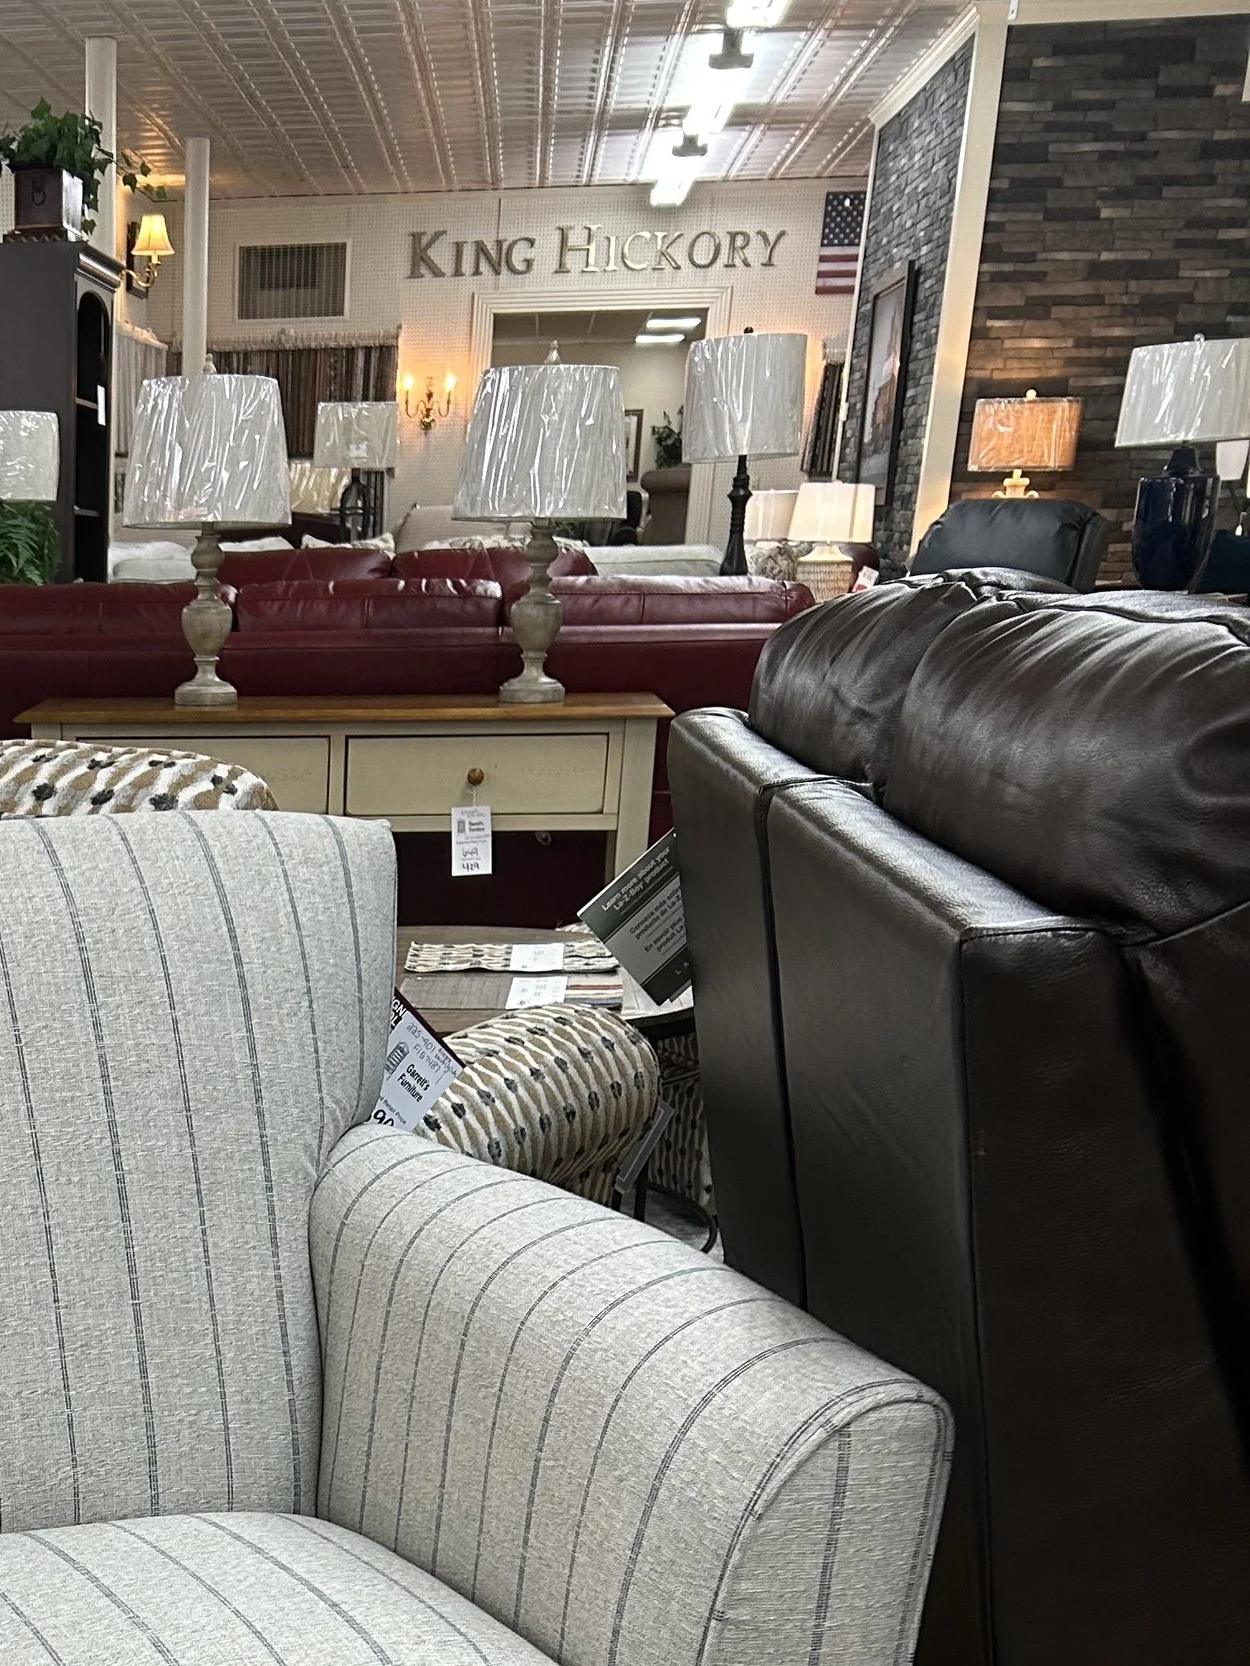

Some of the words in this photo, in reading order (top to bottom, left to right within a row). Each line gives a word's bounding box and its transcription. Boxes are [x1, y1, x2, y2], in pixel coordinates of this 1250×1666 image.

[406, 229, 537, 279] KING
[553, 223, 788, 275] HICKORY
[601, 892, 622, 911] Learn
[620, 877, 639, 894] more
[637, 860, 656, 879] about
[655, 846, 671, 862] your
[643, 858, 670, 884] product
[397, 1073, 424, 1102] Furniture
[406, 1063, 431, 1092] Garrett's
